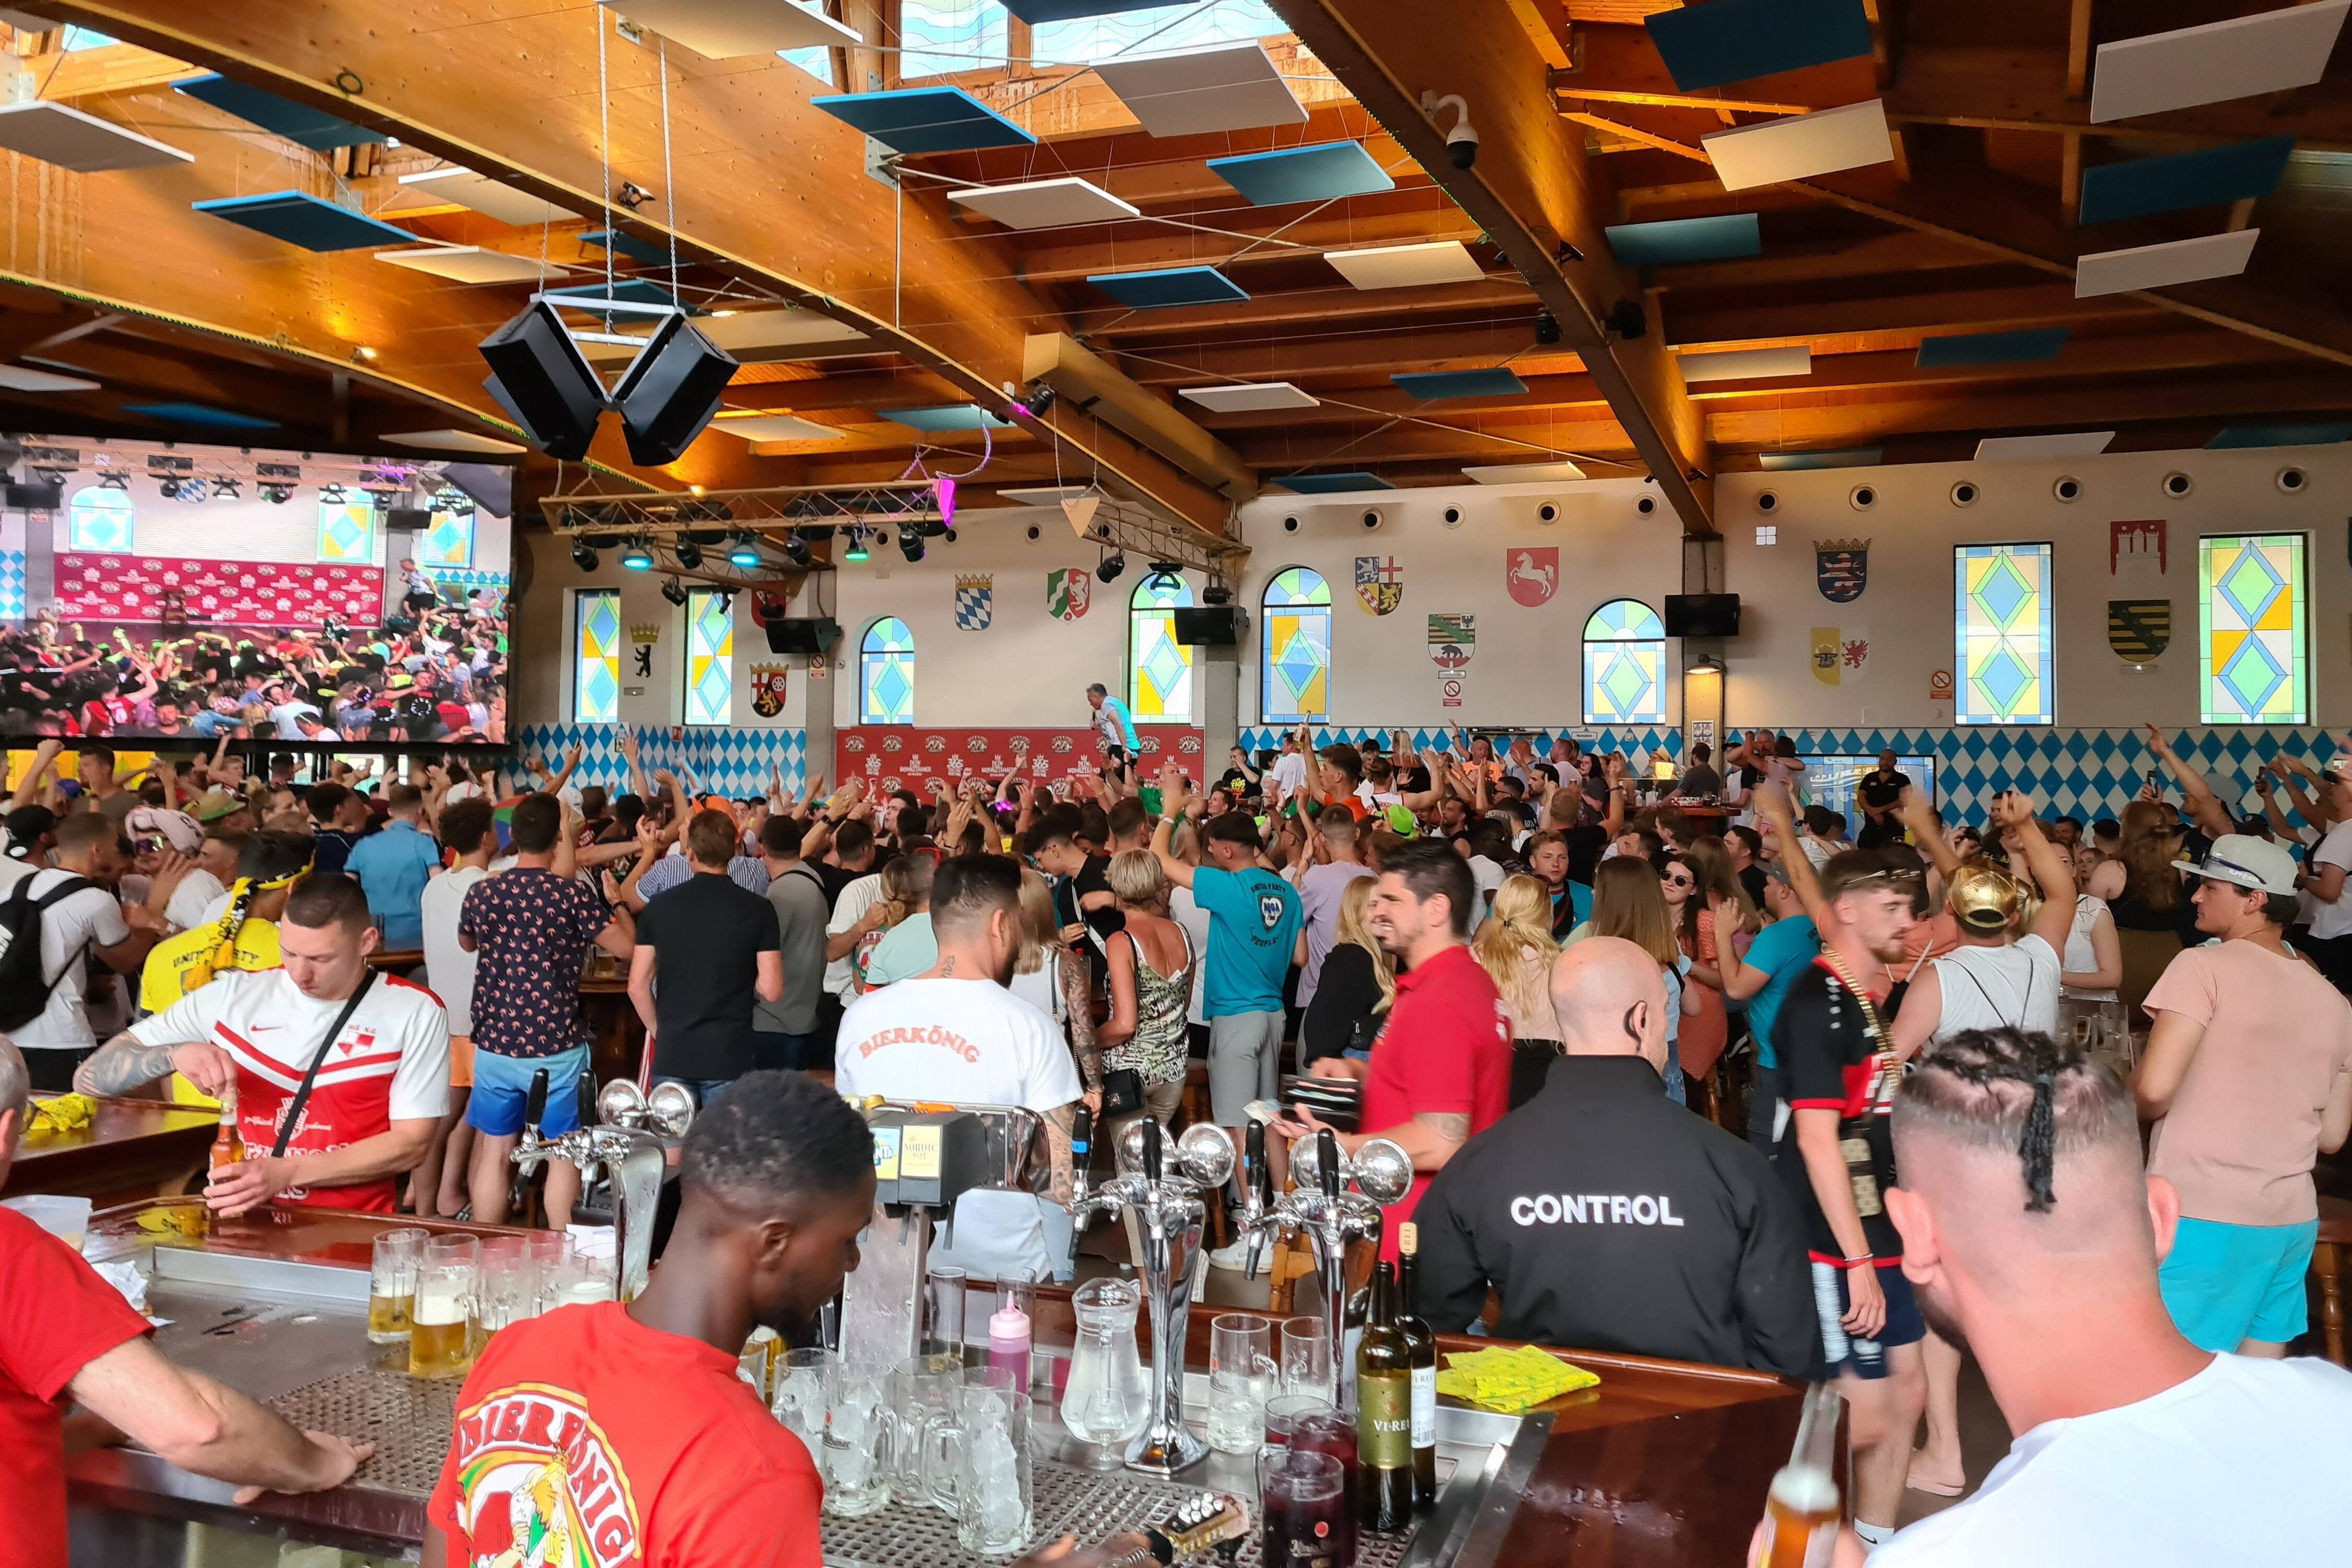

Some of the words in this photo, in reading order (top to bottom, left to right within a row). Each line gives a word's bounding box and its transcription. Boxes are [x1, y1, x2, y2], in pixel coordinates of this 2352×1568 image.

[866, 757, 881, 765] 365
[947, 757, 964, 767] 365
[1033, 758, 1049, 768] 365
[1267, 883, 1287, 894] PARTY
[1251, 934, 1277, 947] PEOPLE
[858, 1025, 981, 1063] BIERKÖNIG
[904, 1144, 938, 1152] NORDIC
[1511, 1194, 1684, 1226] CONTROL
